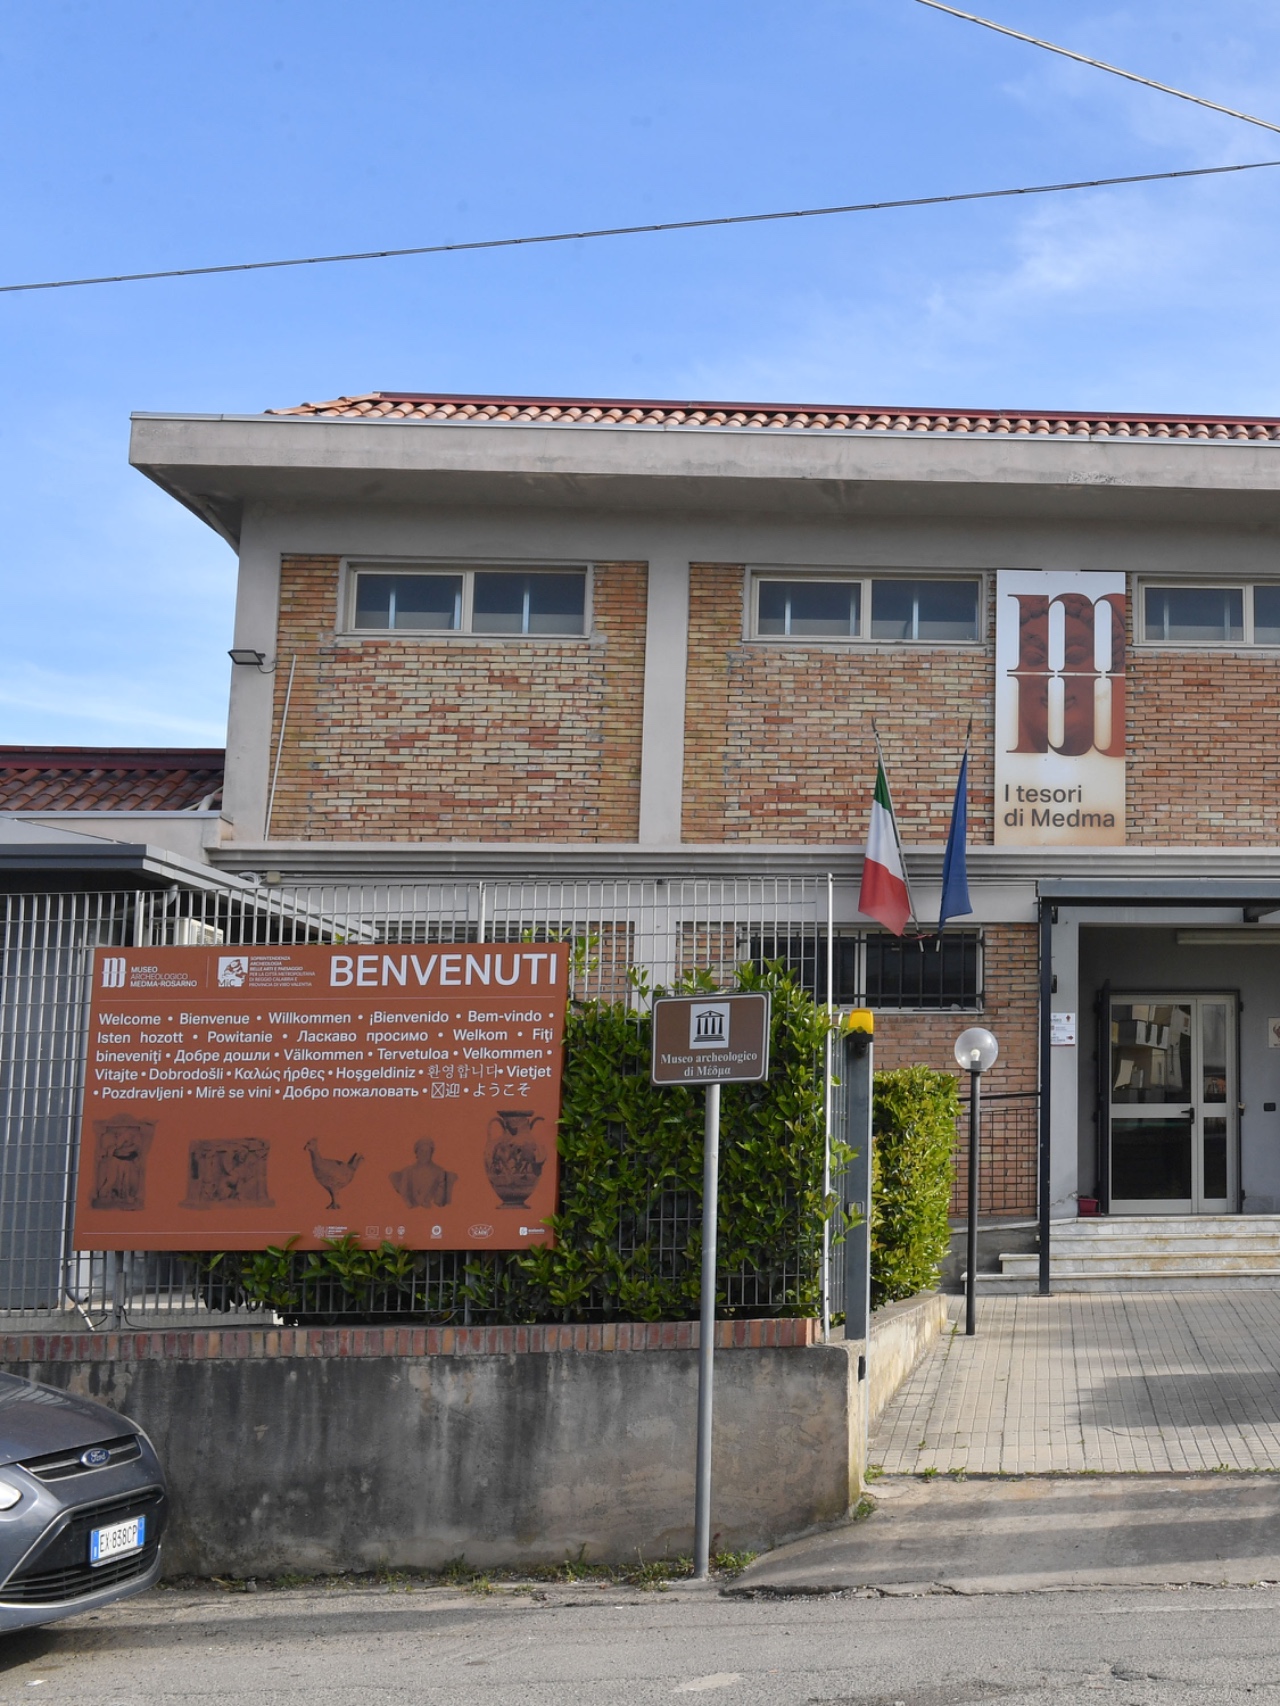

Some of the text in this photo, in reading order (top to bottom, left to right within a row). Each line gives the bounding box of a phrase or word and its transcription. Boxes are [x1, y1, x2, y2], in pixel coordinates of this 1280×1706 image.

[1004, 784, 1083, 803] I tesori
[1003, 807, 1116, 828] di Medma
[329, 953, 557, 987] BENVENUTI
[99, 1010, 542, 1026] Welcome Bienvenue Willkommen ¡Bienvenido Bem-vindo
[97, 1031, 130, 1044] Isten
[140, 1031, 183, 1044] hozott
[207, 1030, 273, 1043] Powitanie
[296, 1030, 357, 1042] Ласкаво
[366, 1032, 428, 1044] просимо
[453, 1029, 508, 1040] Welkom
[174, 1050, 220, 1064] Добре
[223, 1052, 271, 1063] дошли
[284, 1049, 364, 1060] Välkommen
[377, 1048, 449, 1060] Tervetuloa
[463, 1047, 543, 1059] Velkommen
[660, 1051, 758, 1064] Museo archeologico
[95, 1068, 138, 1083] Vitajte
[149, 1068, 224, 1080] Dobrodošli
[336, 1066, 416, 1082] Hoşgeldiniz
[428, 1063, 499, 1078] 환영합니다
[506, 1065, 552, 1080] Vietjet
[684, 1066, 694, 1077] di
[102, 1086, 184, 1101] Pozdravljeni
[196, 1086, 225, 1098] Mirë
[229, 1089, 244, 1098] se
[248, 1086, 272, 1098] vini
[283, 1086, 330, 1100] Добро
[333, 1088, 419, 1098] пожаловать
[473, 1082, 531, 1098] ようこそ
